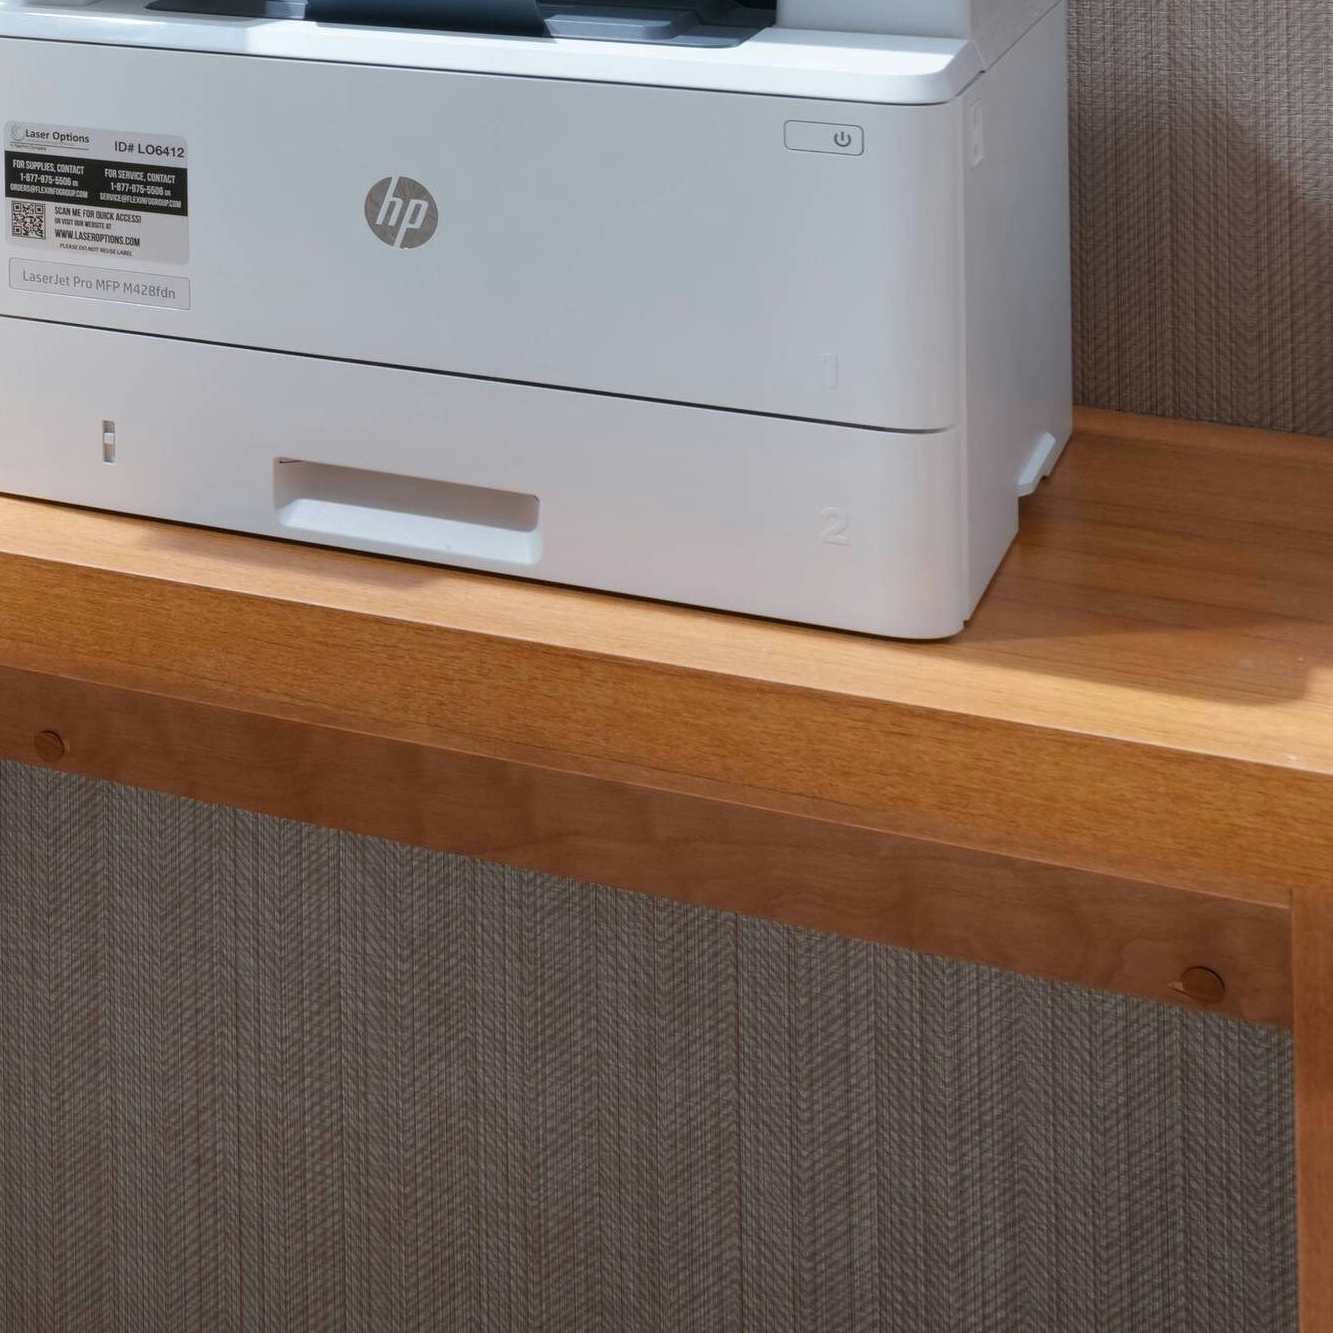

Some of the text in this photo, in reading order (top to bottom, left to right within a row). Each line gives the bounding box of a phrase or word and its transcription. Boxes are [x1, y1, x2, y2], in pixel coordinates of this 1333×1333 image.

[25, 128, 90, 143] Laser Options
[114, 140, 134, 153] ID#
[13, 159, 25, 168] FOR
[57, 164, 85, 175] CONTACT
[104, 168, 117, 178] FOR
[147, 173, 175, 184] CONTACT
[54, 206, 71, 216] SCAN
[72, 208, 81, 217] ME
[83, 209, 94, 218] FOR
[374, 176, 430, 248] hp
[54, 228, 140, 246] WWW.LASEROPTIONS.COM
[59, 243, 78, 251] PLEASE
[22, 270, 176, 299] LaserJet Pro MFP M428fdn
